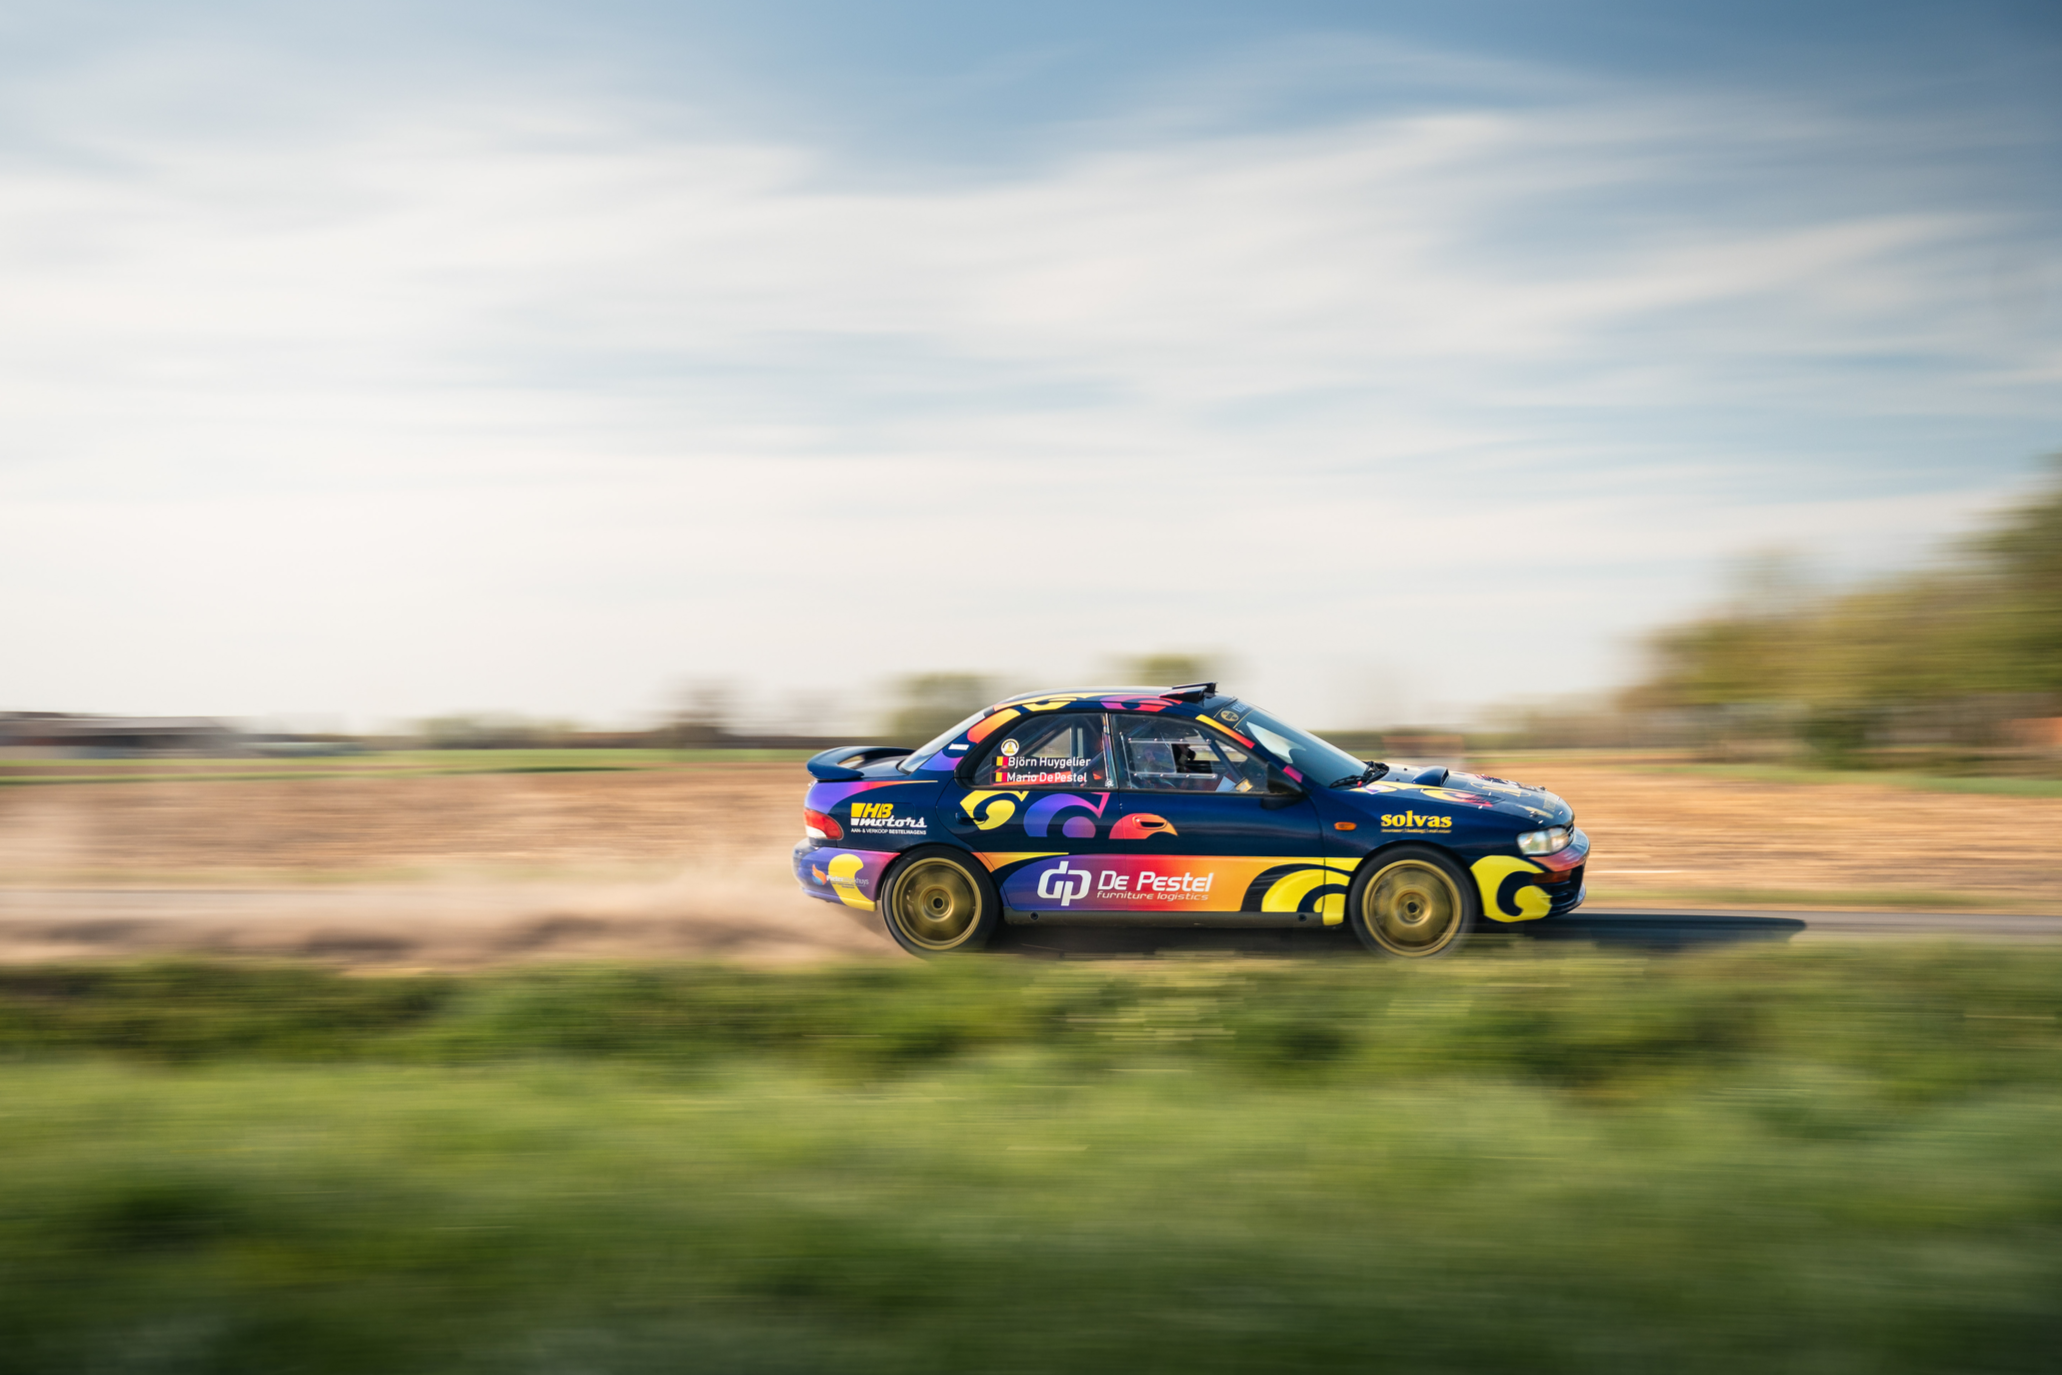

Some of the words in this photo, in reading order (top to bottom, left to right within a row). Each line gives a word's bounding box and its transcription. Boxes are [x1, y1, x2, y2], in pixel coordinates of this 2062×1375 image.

[1008, 756, 1037, 769] Björn
[1040, 756, 1091, 769] Huygelier
[1007, 771, 1037, 782] Mario
[862, 803, 894, 818] HB
[859, 815, 927, 828] motors
[1381, 810, 1452, 828] solvas
[1097, 870, 1130, 891] De
[1136, 871, 1214, 892] Pestel
[1097, 891, 1154, 900] furniture
[1157, 892, 1209, 902] logistics
